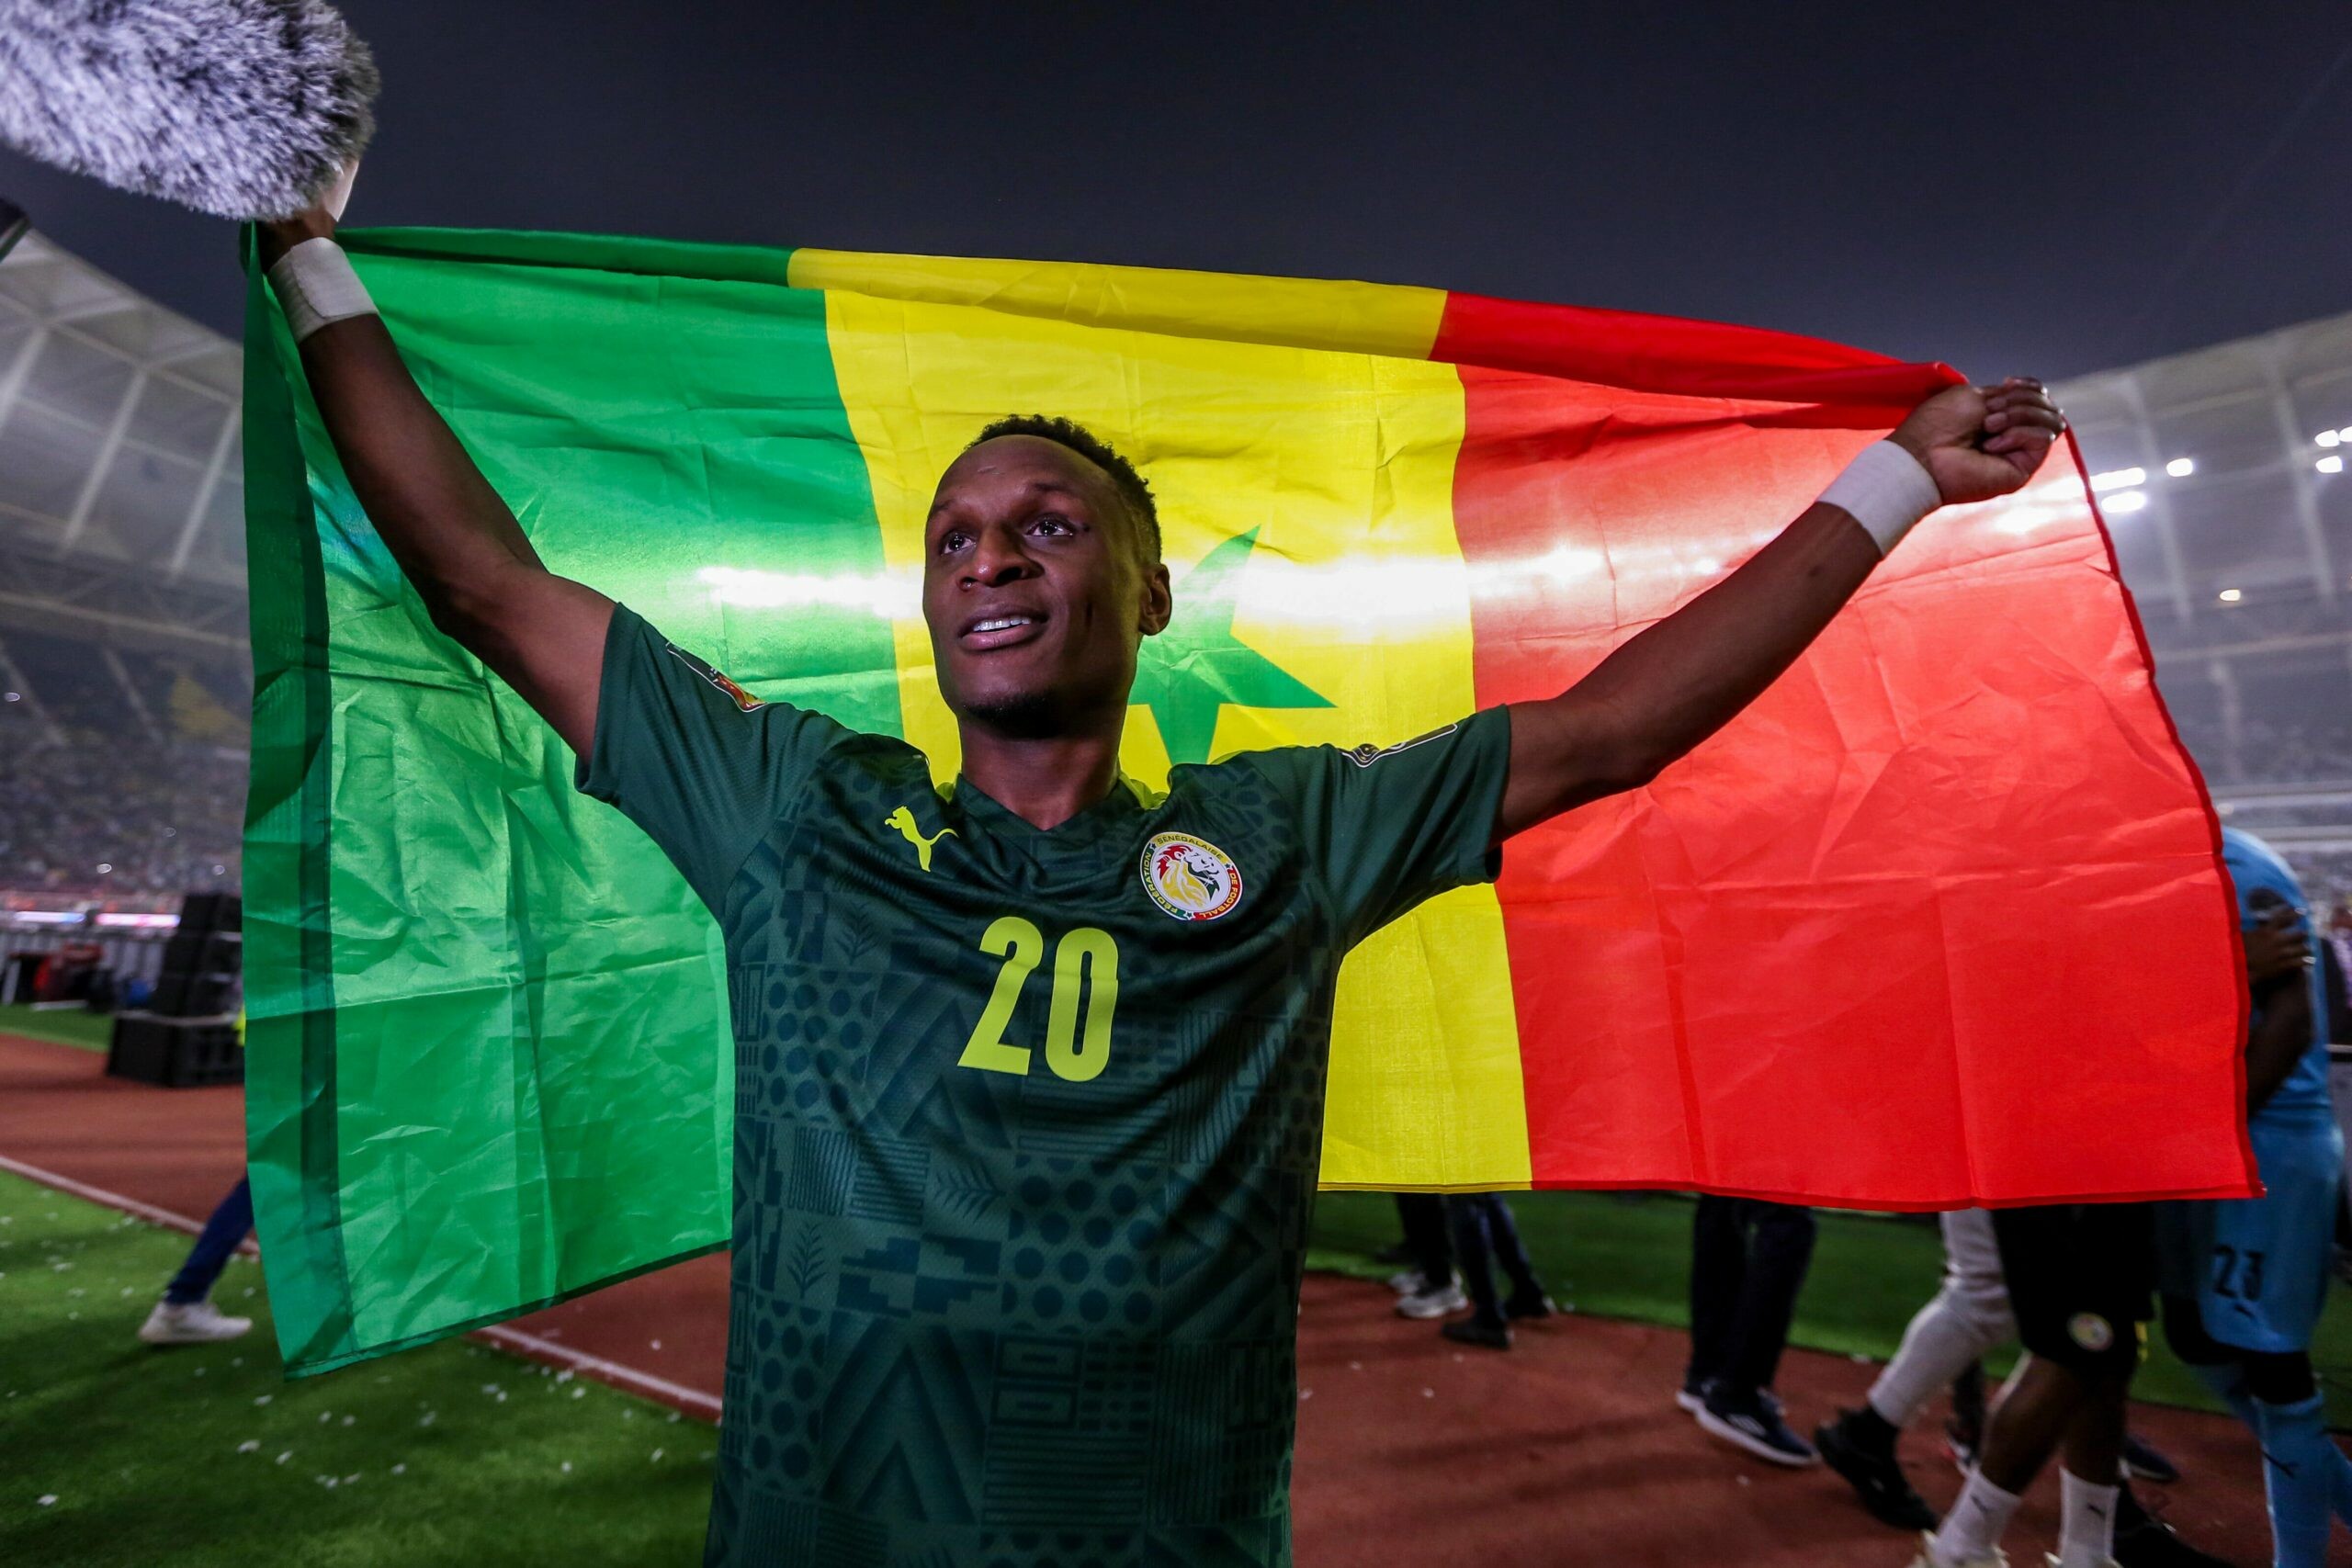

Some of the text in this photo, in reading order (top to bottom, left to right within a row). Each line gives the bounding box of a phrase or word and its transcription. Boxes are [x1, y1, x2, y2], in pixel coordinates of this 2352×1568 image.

[1199, 872, 1238, 918] DE FOOTBALL
[956, 916, 1119, 1082] 20
